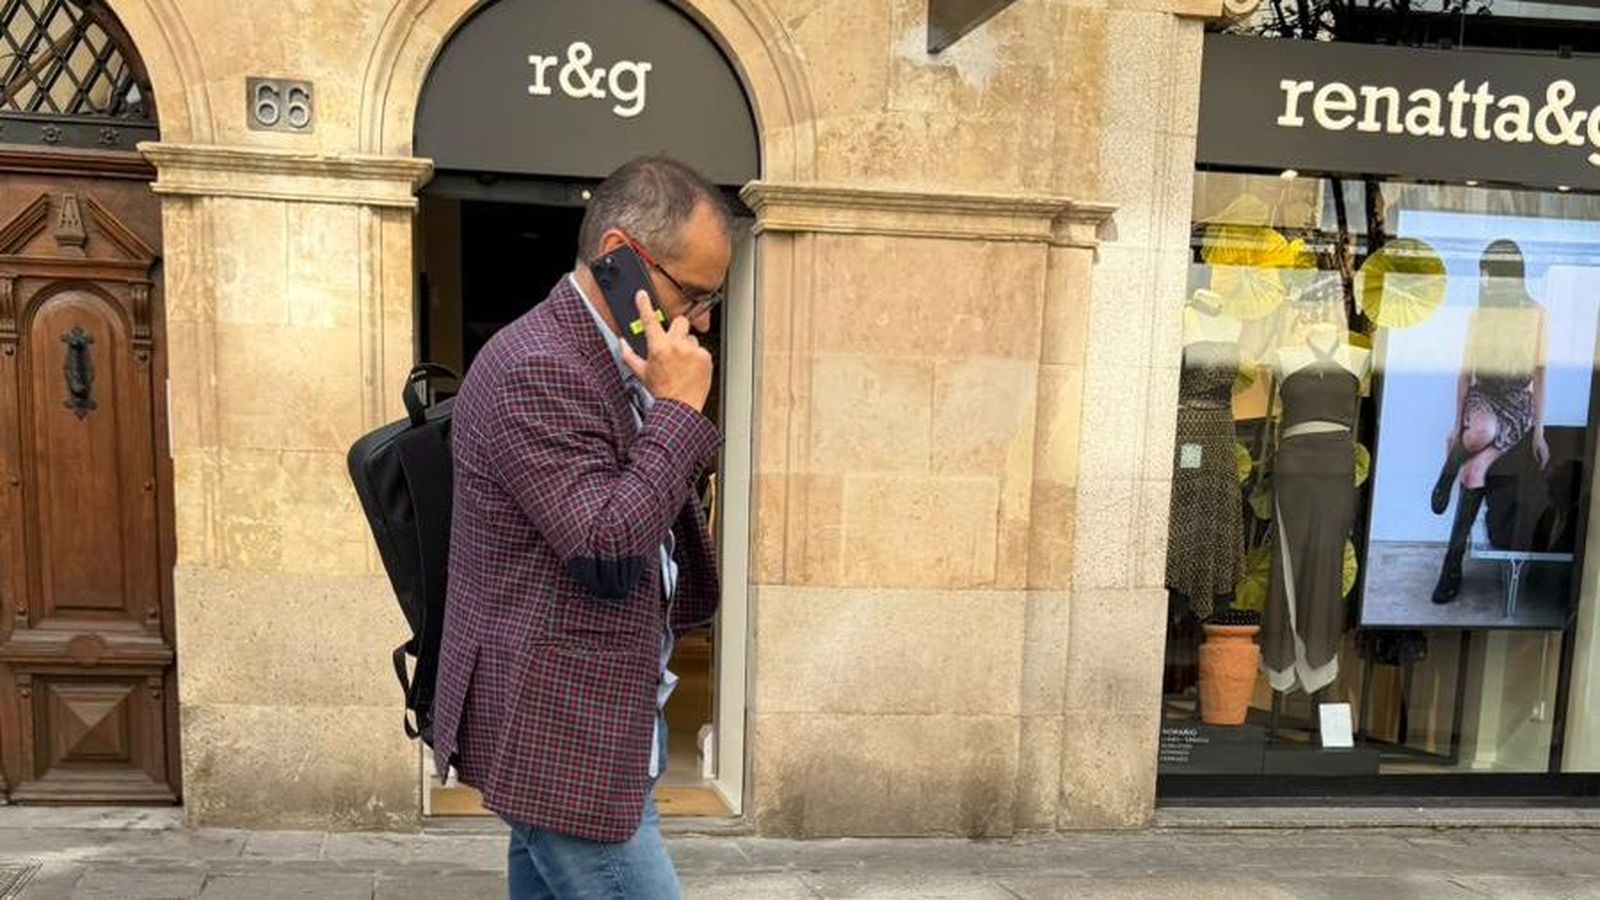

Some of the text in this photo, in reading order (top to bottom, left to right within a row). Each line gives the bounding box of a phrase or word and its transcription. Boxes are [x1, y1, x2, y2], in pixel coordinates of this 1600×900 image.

[255, 83, 311, 129] 66
[527, 41, 652, 118] r&g
[1276, 78, 1600, 167] renatta&
